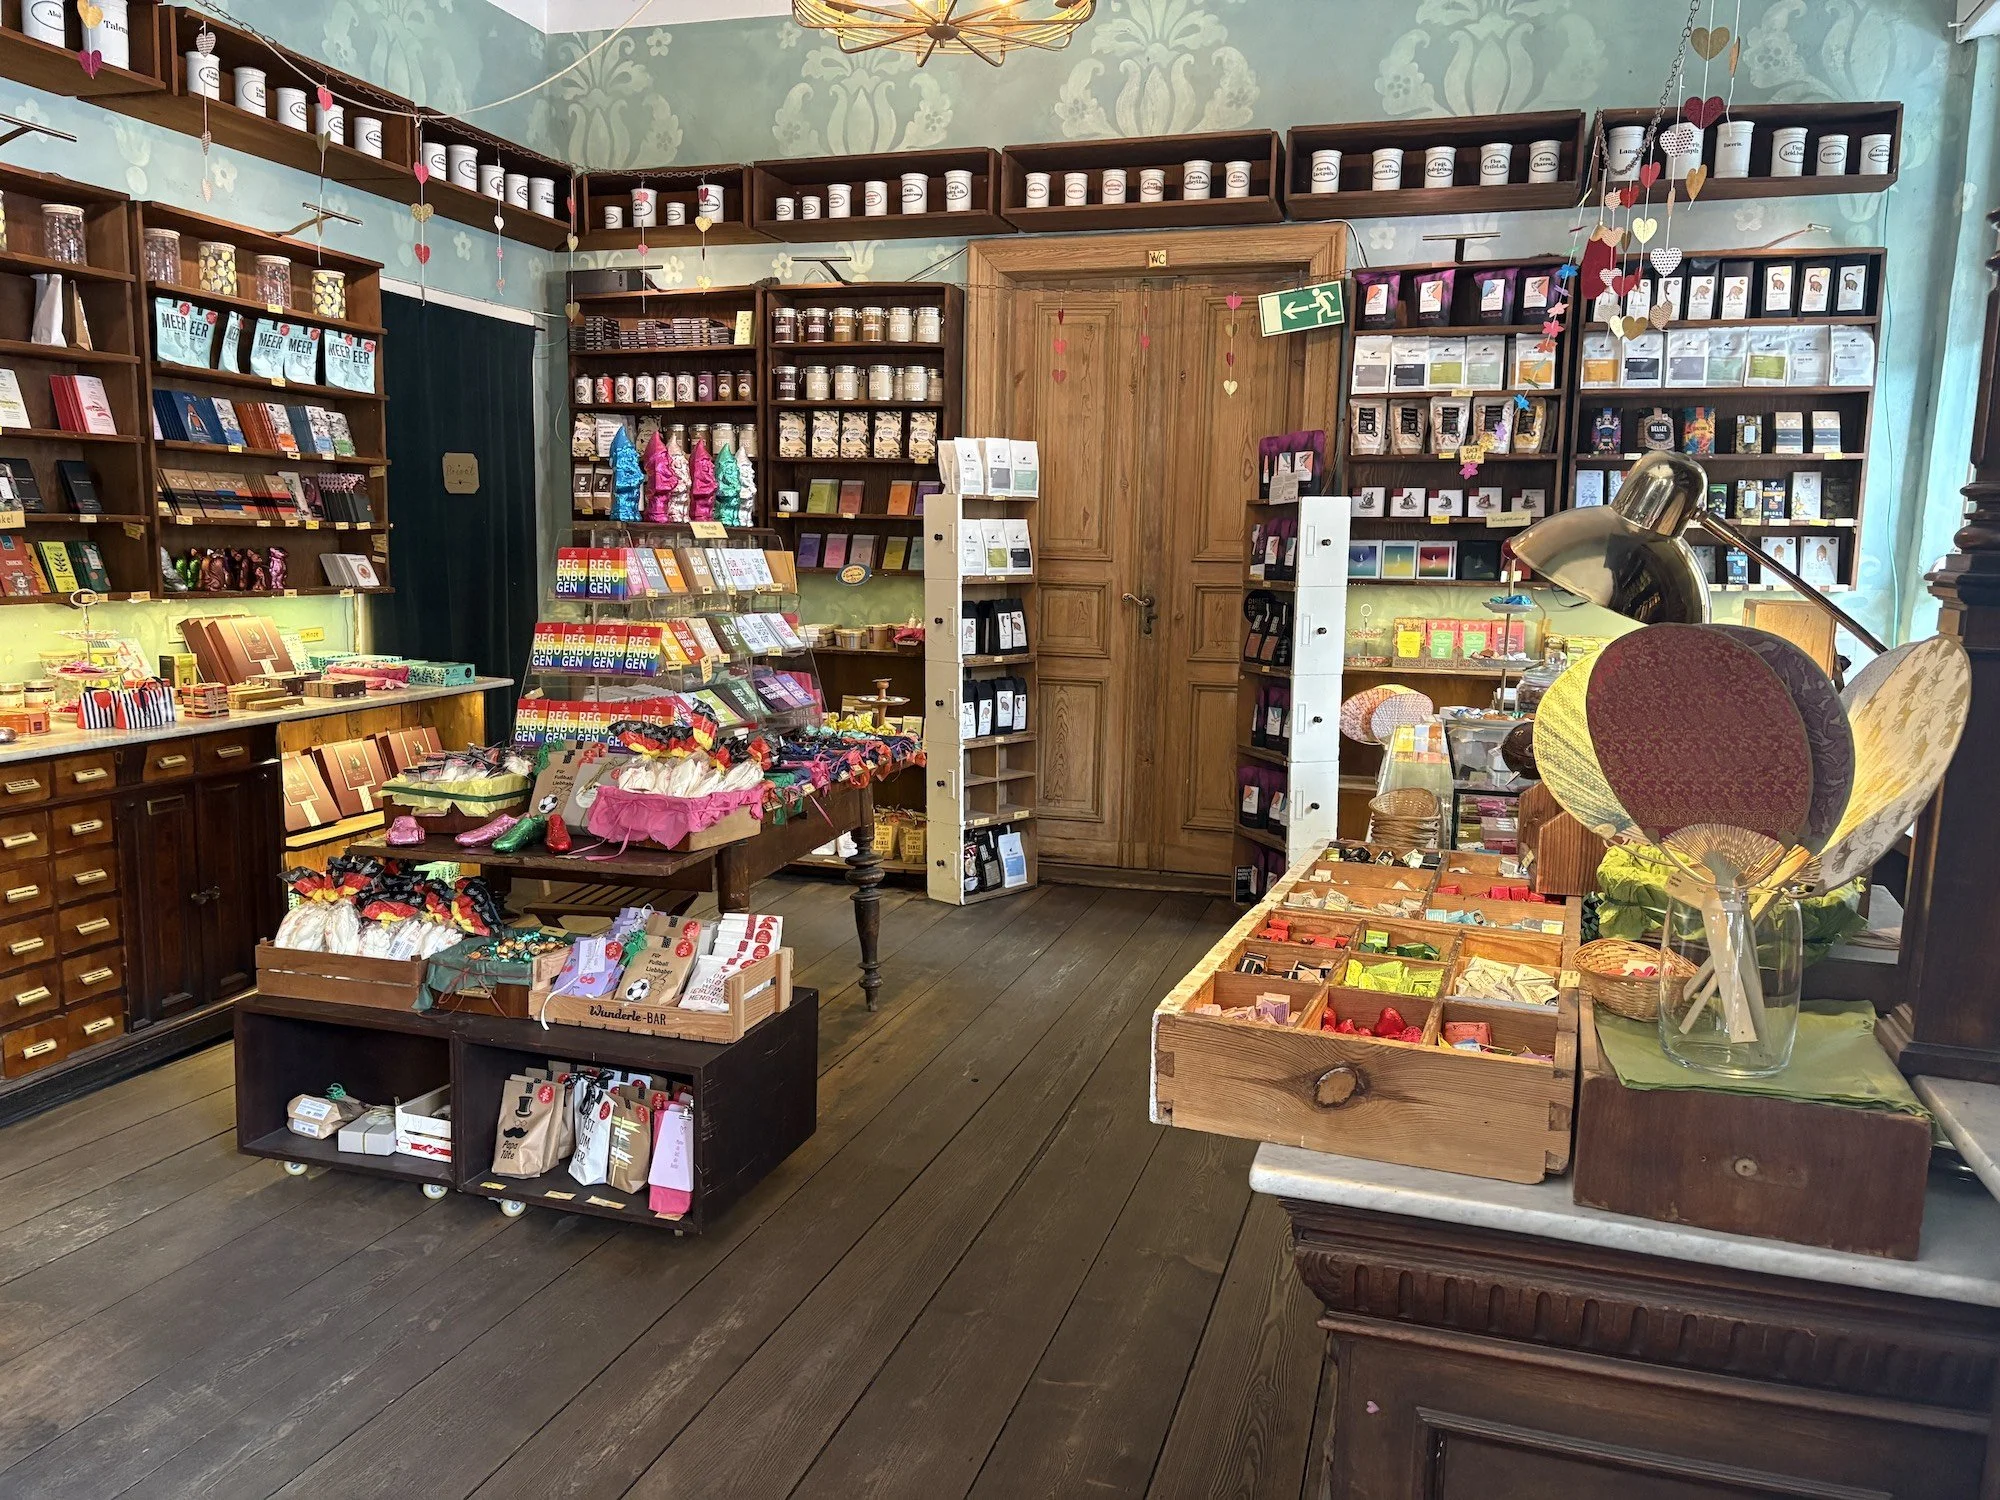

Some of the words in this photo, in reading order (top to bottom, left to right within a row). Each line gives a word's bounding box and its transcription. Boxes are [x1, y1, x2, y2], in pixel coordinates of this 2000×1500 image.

[1150, 252, 1166, 264] WC
[162, 312, 186, 331] MEER
[190, 320, 208, 338] EER
[258, 332, 282, 350] MEER
[288, 338, 312, 355] MEER
[328, 342, 350, 359] MEER
[353, 350, 370, 364] EER
[558, 559, 578, 570] REG
[590, 560, 612, 570] REG
[557, 570, 586, 582] ENBO
[589, 571, 619, 582] ENBO
[556, 582, 577, 592] GEN
[590, 582, 611, 594] GEN
[720, 624, 738, 635] MIN
[535, 632, 554, 644] REG
[564, 634, 586, 645] REG
[596, 635, 617, 646] REG
[629, 636, 650, 648] REG
[727, 636, 739, 646] ZE
[534, 644, 560, 655] ENBO
[562, 644, 593, 656] ENBO
[594, 646, 624, 658] ENBO
[626, 647, 656, 660] ENBO
[532, 655, 553, 666] GEN
[562, 656, 583, 667] GEN
[592, 657, 614, 668] GEN
[625, 658, 647, 670] GEN
[517, 709, 538, 720] REG
[548, 711, 570, 722] REG
[579, 711, 601, 723] REG
[642, 714, 663, 726] REG
[516, 720, 544, 732] ENBO
[547, 722, 575, 733] ENBO
[578, 723, 609, 735] ENBO
[514, 731, 536, 742] GEN
[646, 966, 672, 975] Liebhaber
[502, 1140, 519, 1150] Papa
